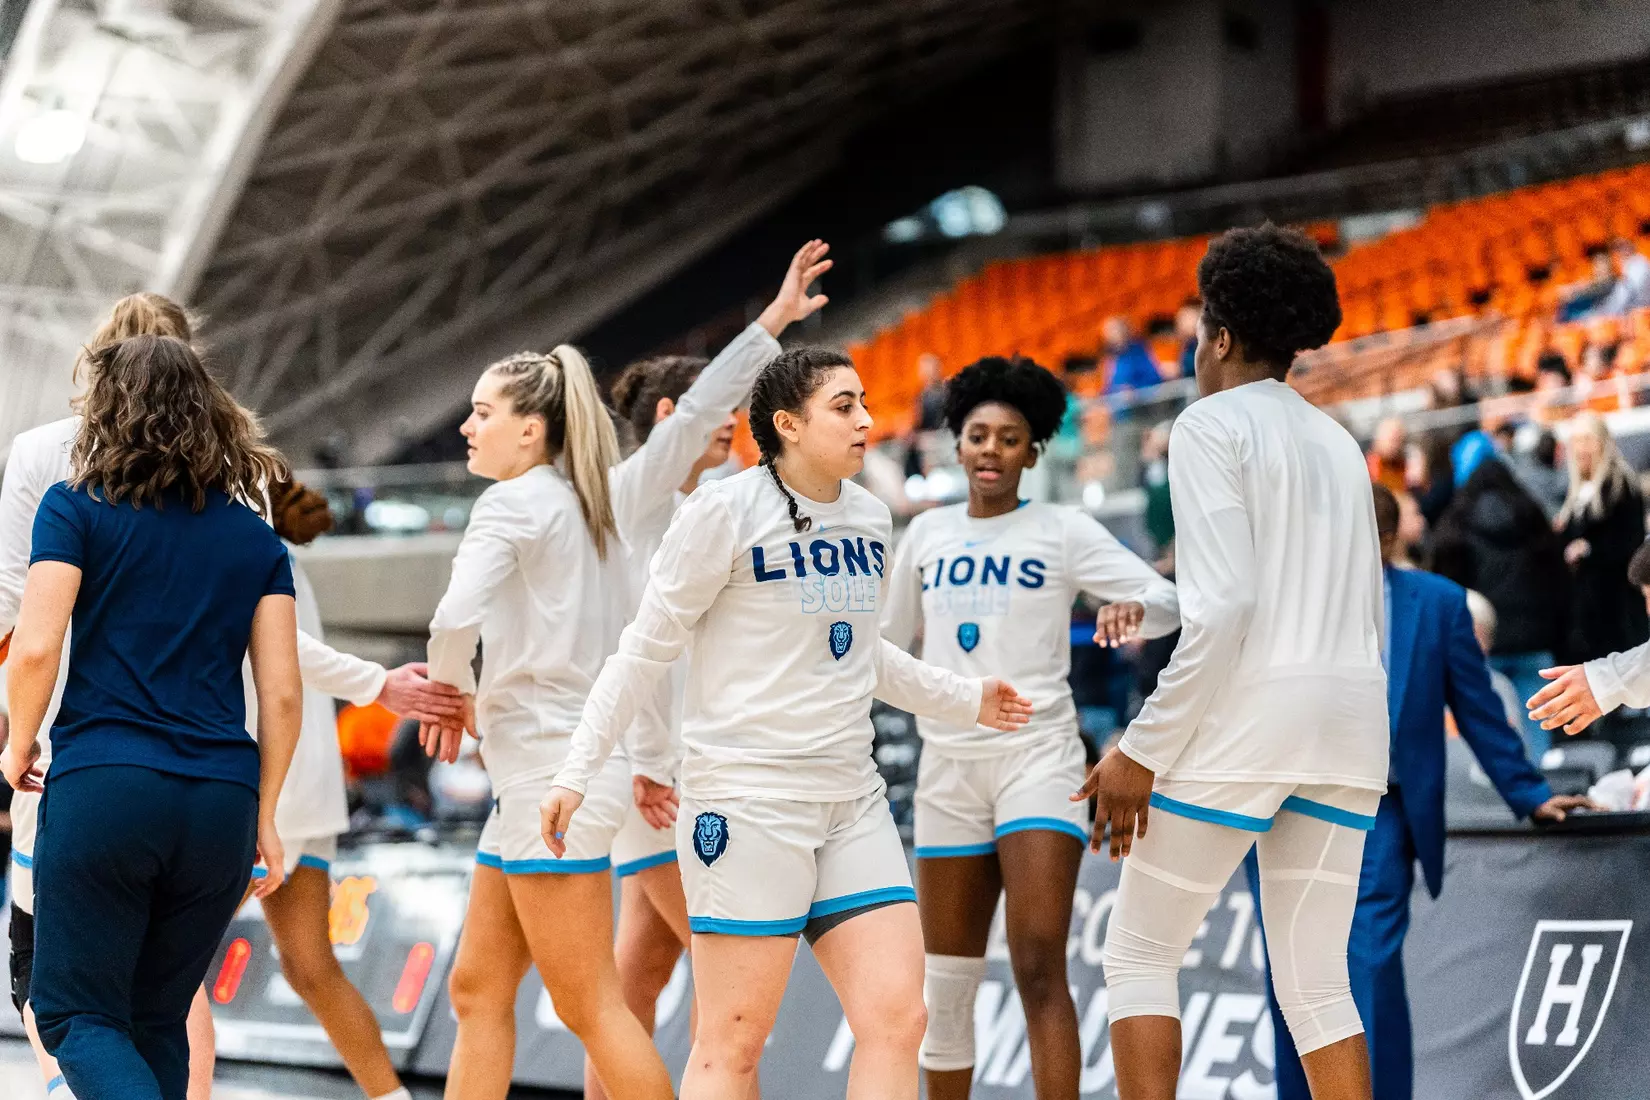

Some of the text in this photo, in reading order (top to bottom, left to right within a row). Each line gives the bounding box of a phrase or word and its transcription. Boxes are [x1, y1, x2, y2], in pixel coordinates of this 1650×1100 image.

[752, 537, 885, 582] LIONS
[801, 572, 876, 613] SOLE
[1524, 943, 1603, 1046] H
